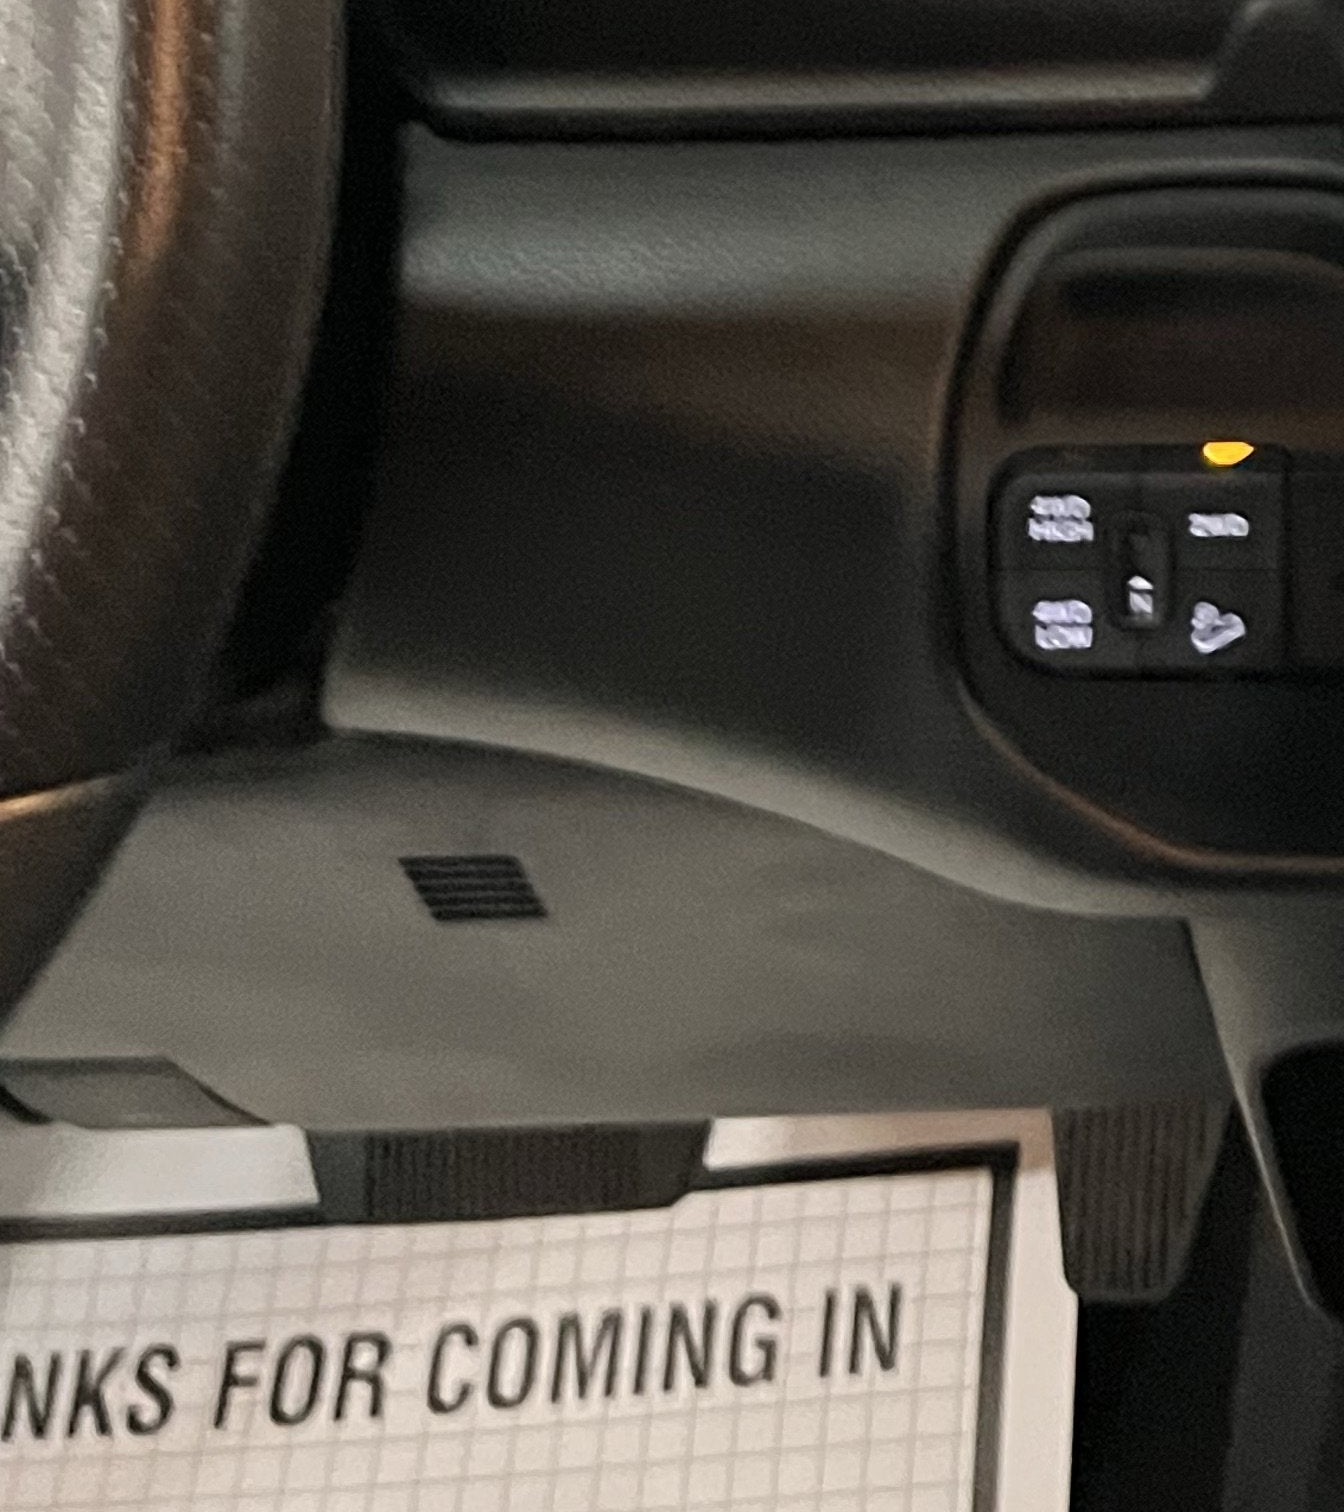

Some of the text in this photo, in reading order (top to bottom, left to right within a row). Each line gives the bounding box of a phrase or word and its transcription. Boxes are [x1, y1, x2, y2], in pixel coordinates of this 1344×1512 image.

[213, 1330, 393, 1430] FOR
[427, 1291, 783, 1416] COMING
[818, 1281, 903, 1379] IN
